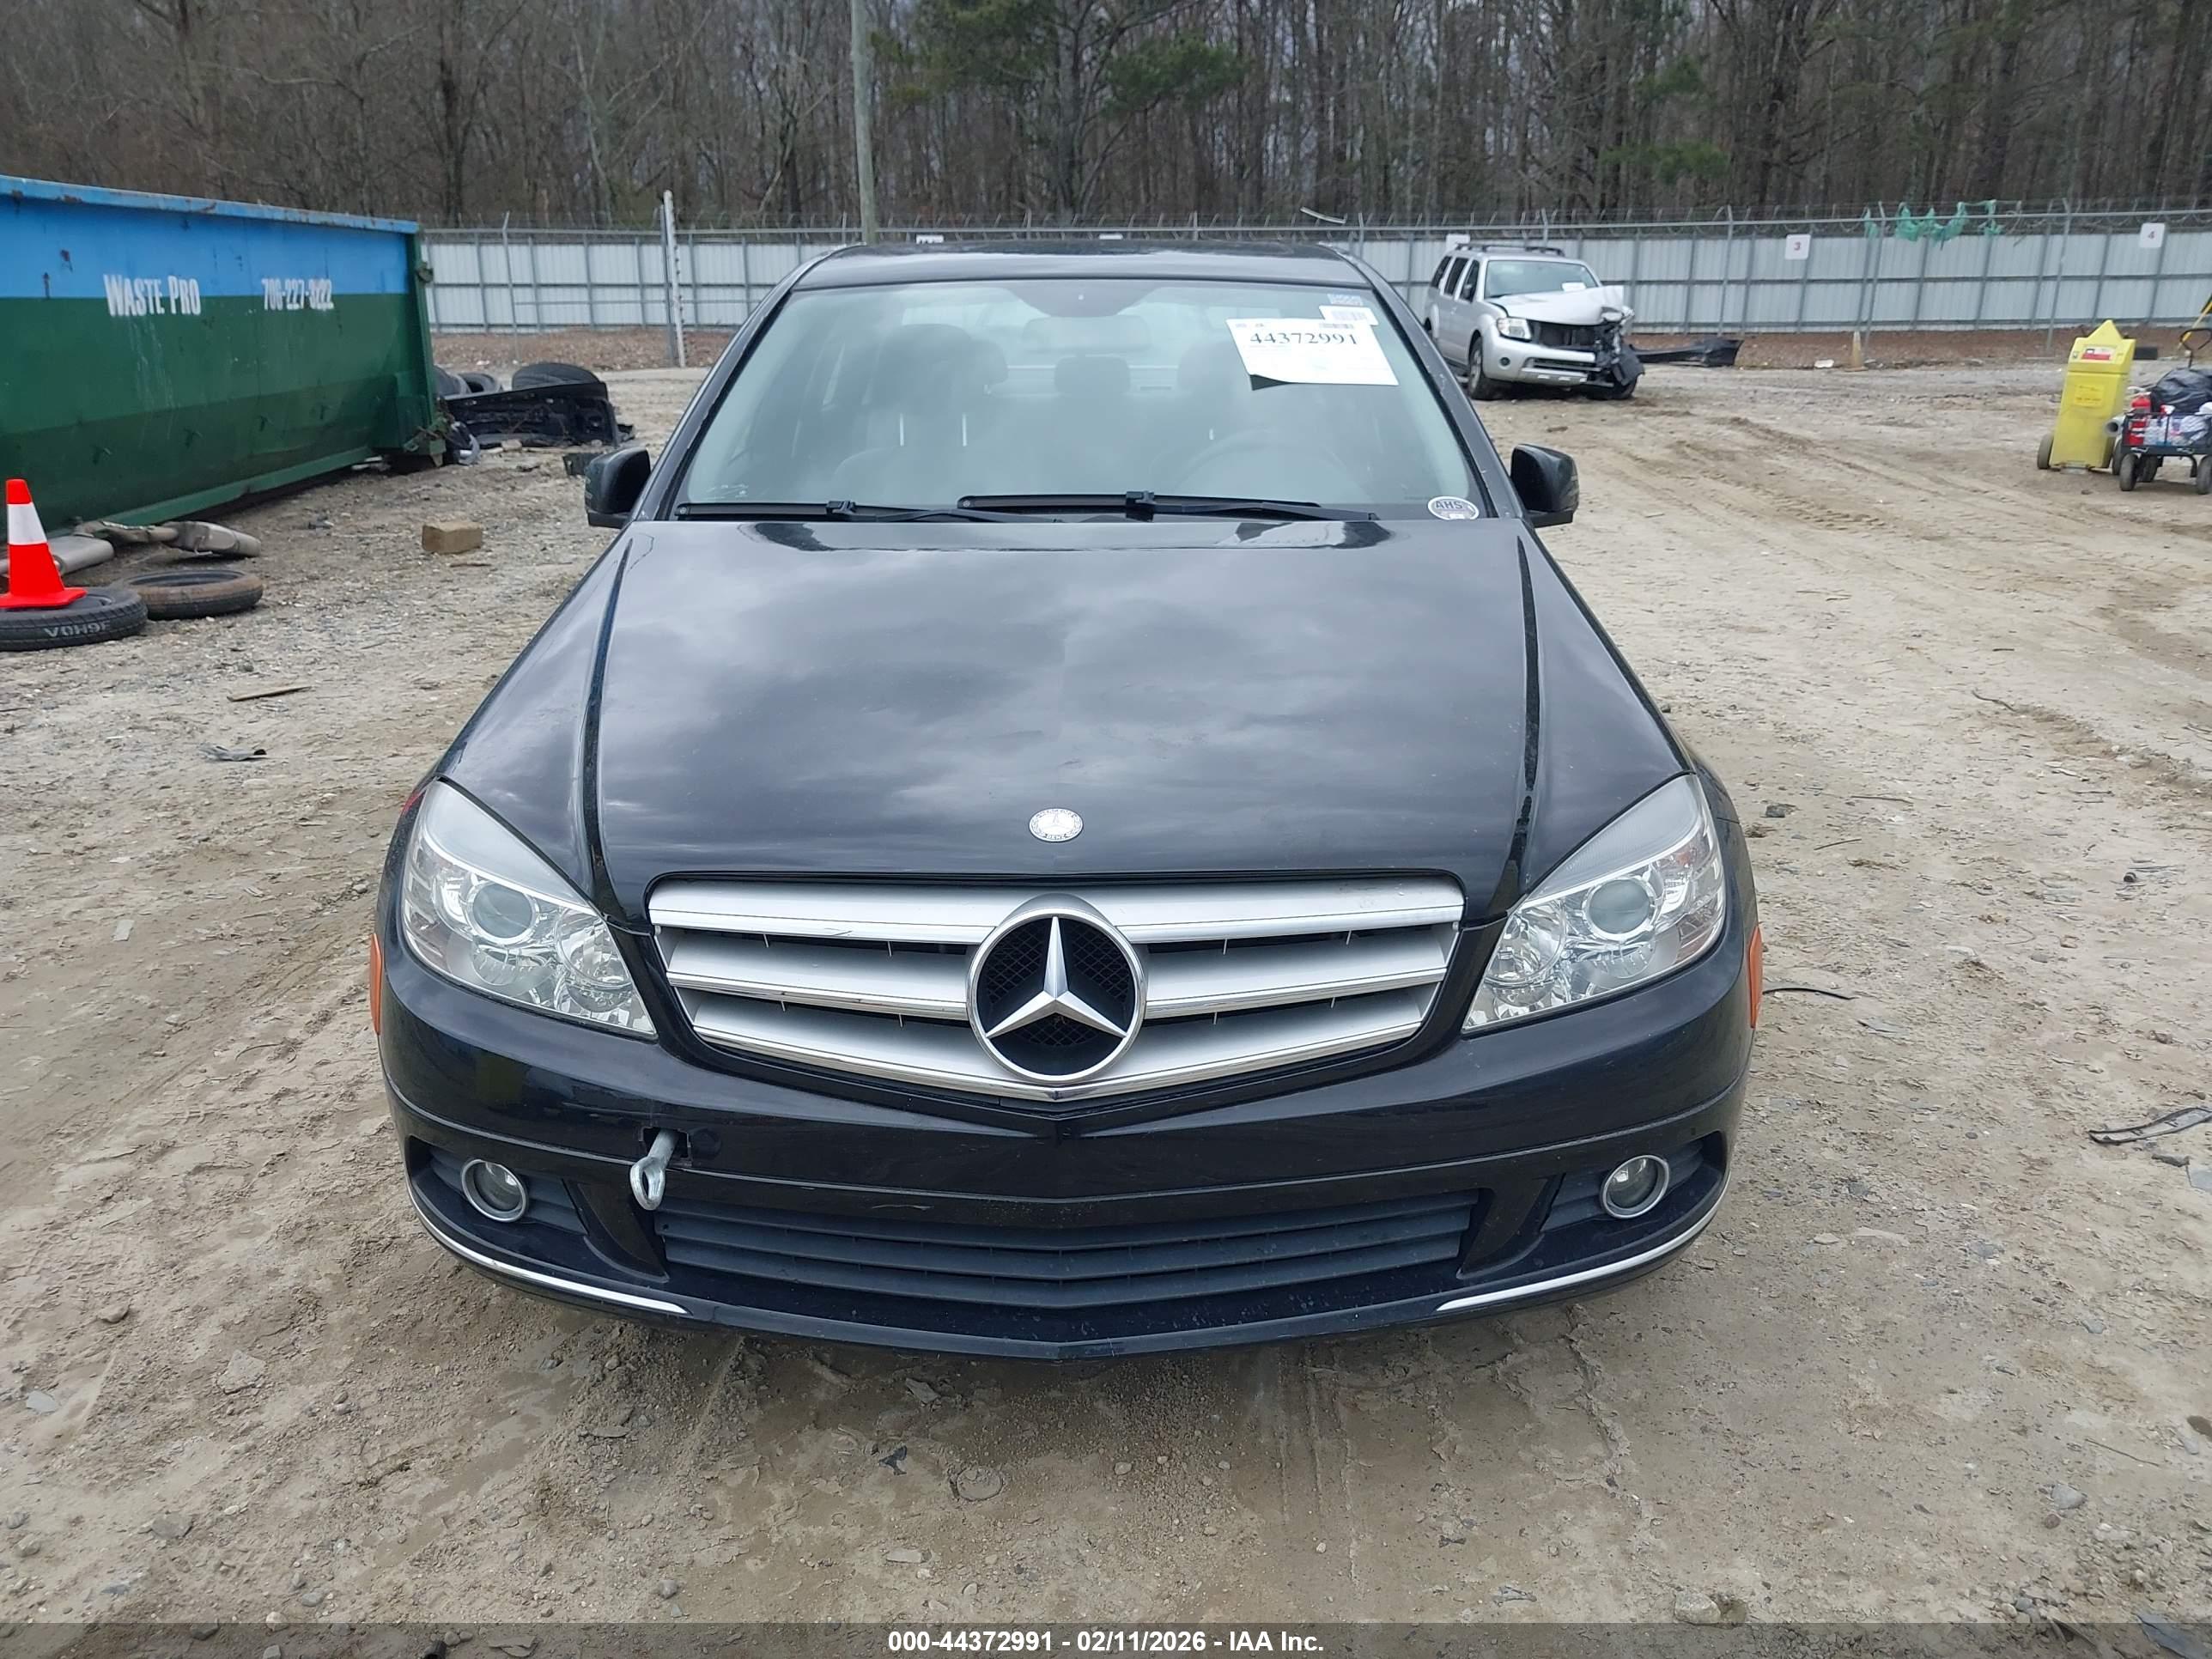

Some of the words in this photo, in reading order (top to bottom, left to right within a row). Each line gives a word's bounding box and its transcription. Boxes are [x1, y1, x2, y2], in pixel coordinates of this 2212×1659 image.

[1794, 241, 1802, 251] 3
[1250, 332, 1358, 345] 44372991
[1435, 501, 1463, 509] AHS
